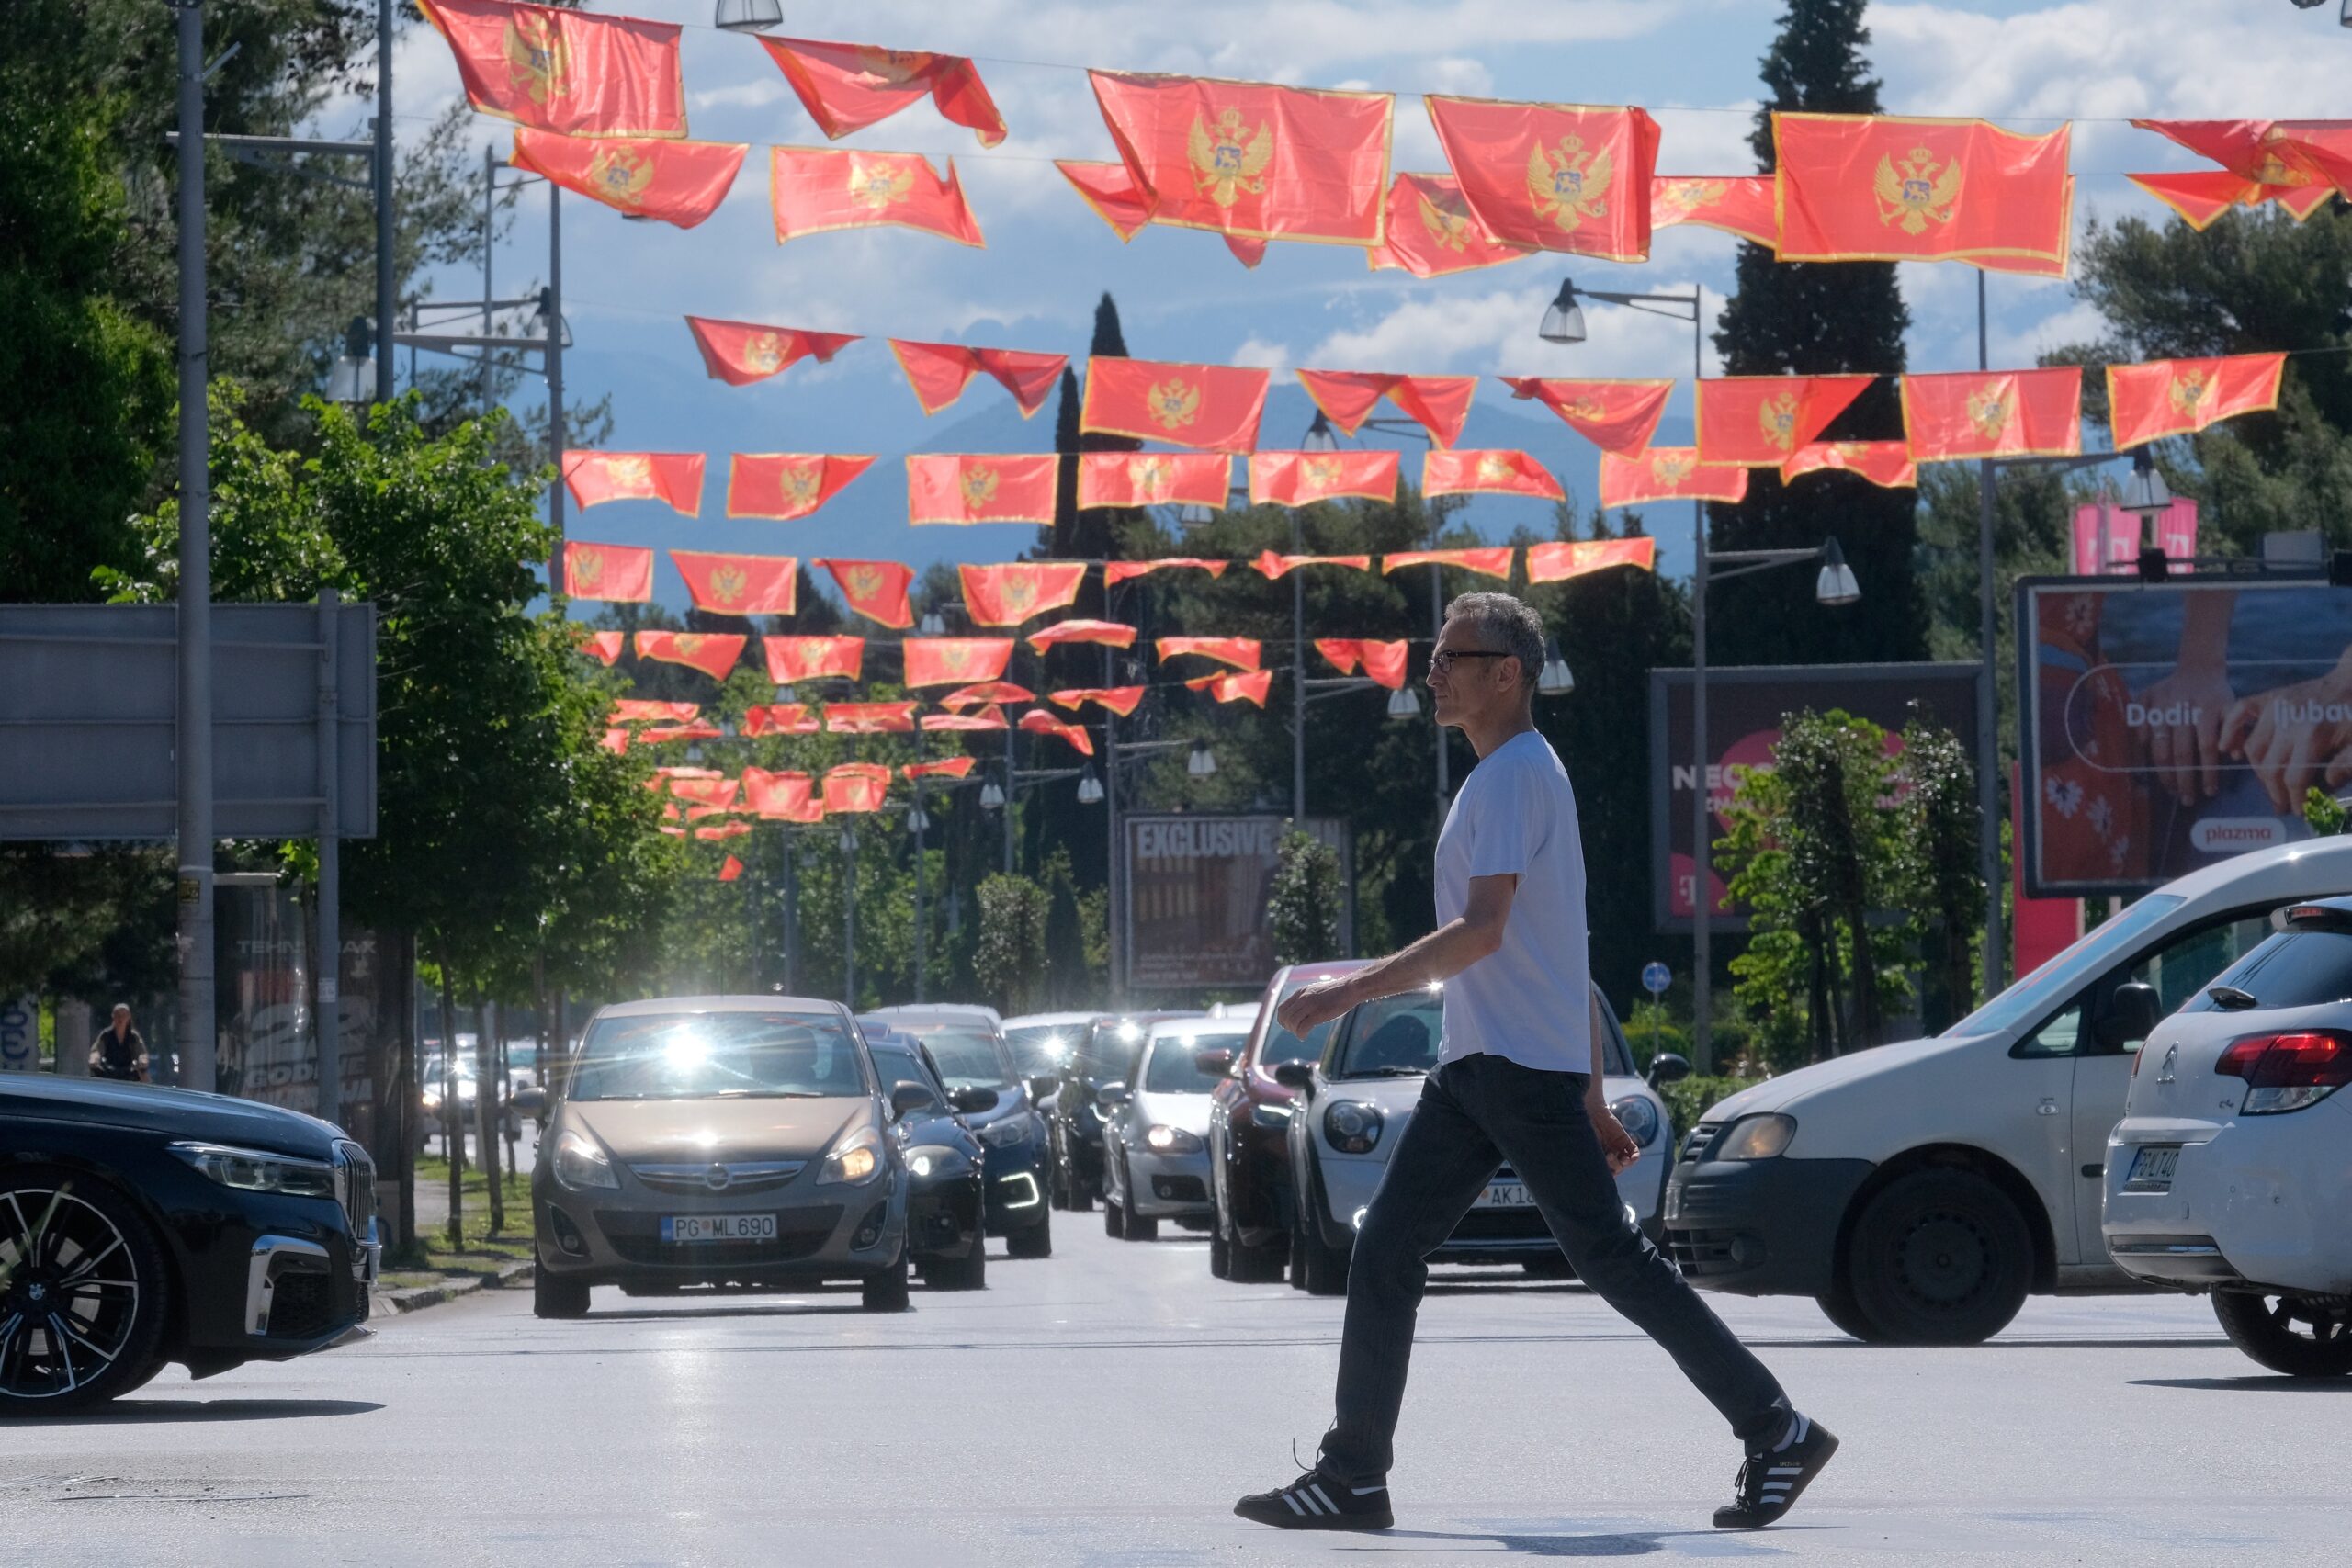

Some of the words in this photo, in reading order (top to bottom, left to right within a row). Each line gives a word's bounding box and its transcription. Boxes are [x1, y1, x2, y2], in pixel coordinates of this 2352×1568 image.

[2126, 701, 2202, 727] Dodir
[1136, 821, 1273, 857] EXCLUSIVE
[2205, 825, 2272, 844] plazma
[236, 940, 377, 954] TEHNAX
[675, 1219, 699, 1238] PG
[713, 1217, 773, 1237] ML690
